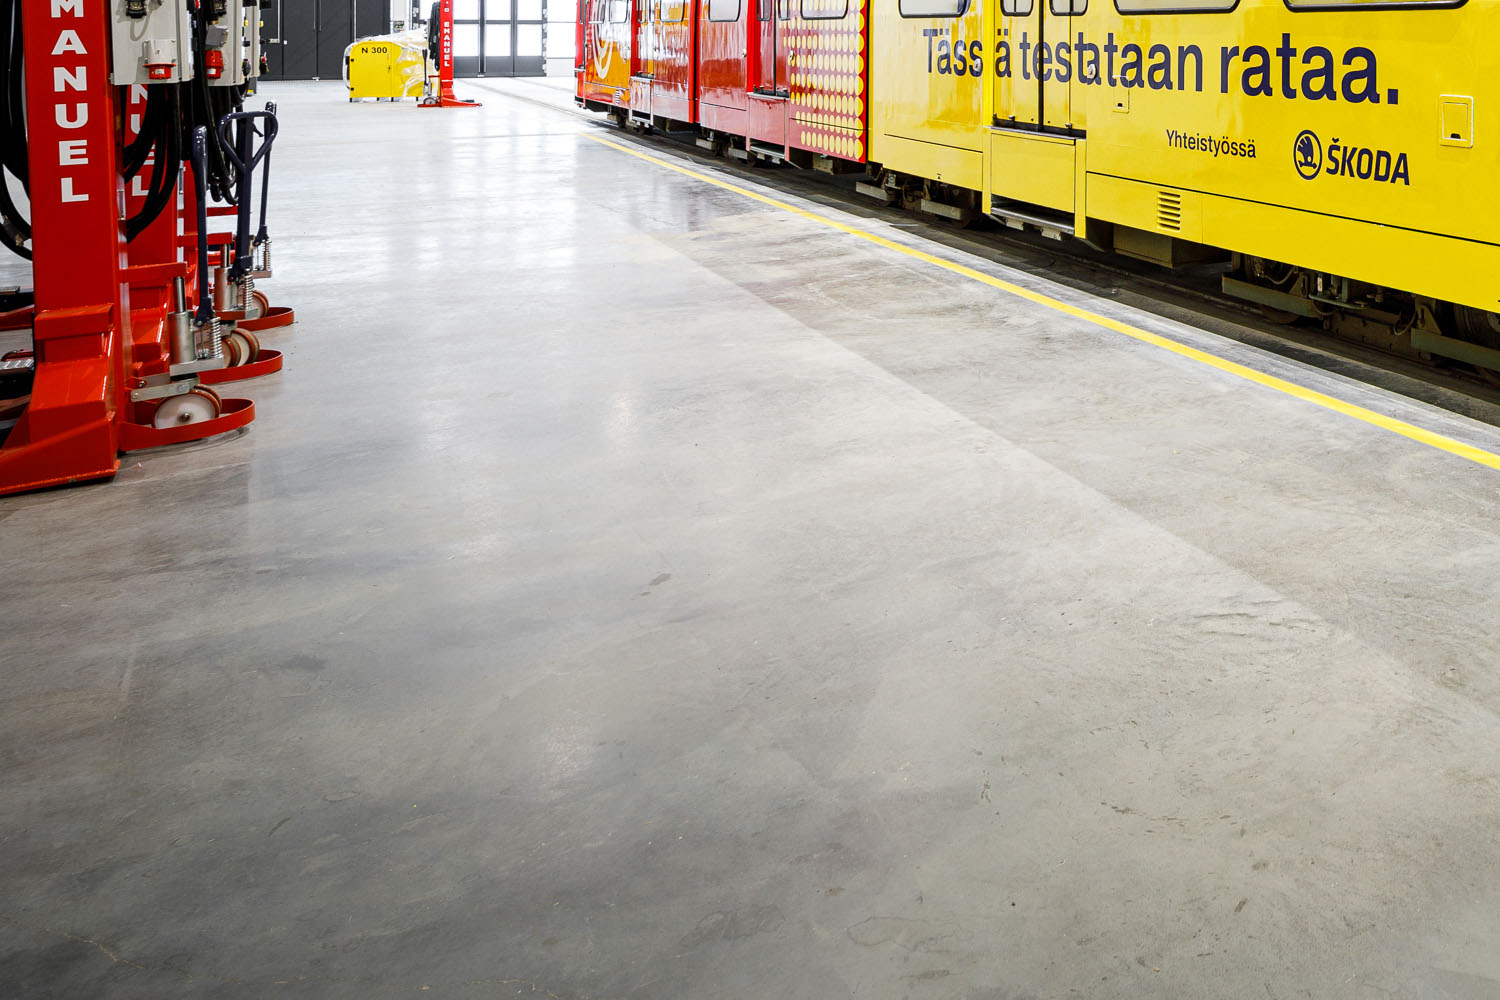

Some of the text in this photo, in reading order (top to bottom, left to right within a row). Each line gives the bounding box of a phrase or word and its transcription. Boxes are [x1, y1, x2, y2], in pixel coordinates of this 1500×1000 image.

[923, 28, 1399, 105] Tässä testataan rataa.
[1166, 129, 1257, 159] Yhteistyössä
[1326, 137, 1411, 187] ŠKODA
